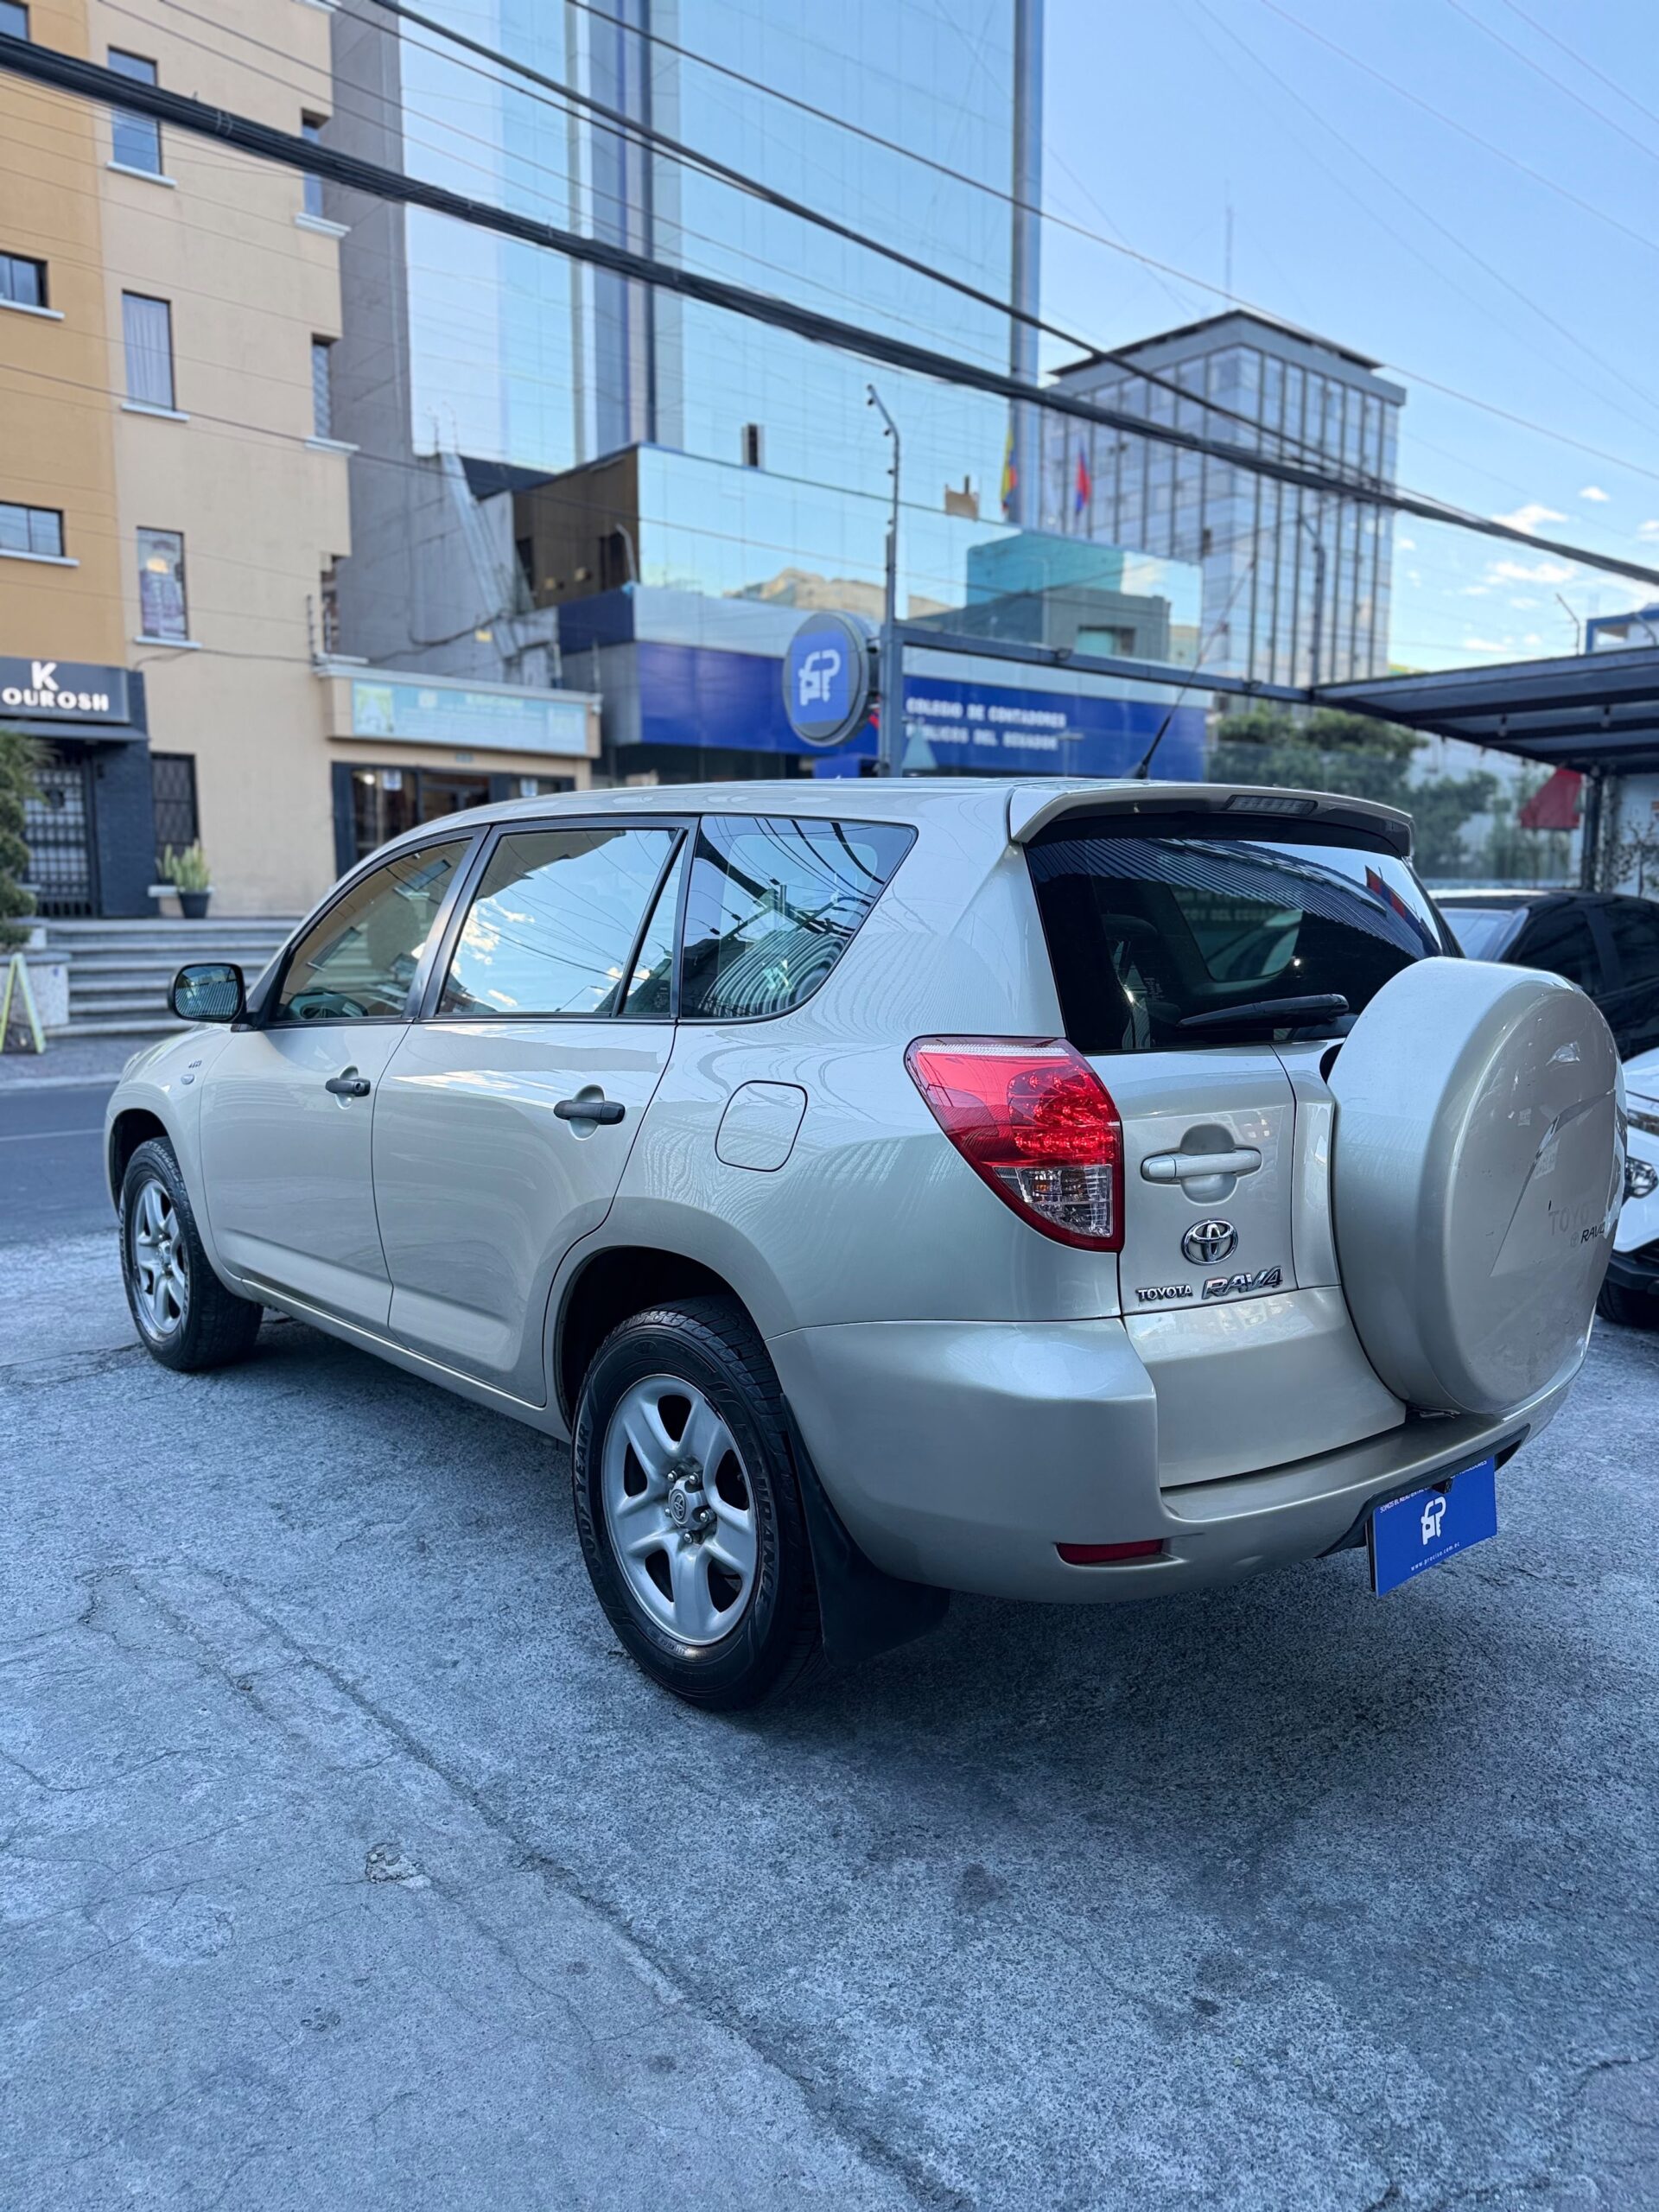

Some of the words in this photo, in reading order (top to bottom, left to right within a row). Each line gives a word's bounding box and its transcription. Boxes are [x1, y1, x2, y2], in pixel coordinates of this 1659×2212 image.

[31, 661, 60, 691] K
[2, 687, 109, 711] OUROSH
[906, 696, 963, 719] COLEGIO
[967, 702, 986, 721] DE
[988, 705, 1067, 728] CONTADORES
[906, 722, 969, 744] PBLICOS
[972, 728, 998, 747] DEL
[1002, 730, 1058, 751] ECUADOR
[1136, 1283, 1194, 1302] TOYOTA
[1201, 1265, 1284, 1300] RAV4
[1380, 1500, 1395, 1513] SOMOS
[1410, 1541, 1460, 1572] www.preciso.com.ec
